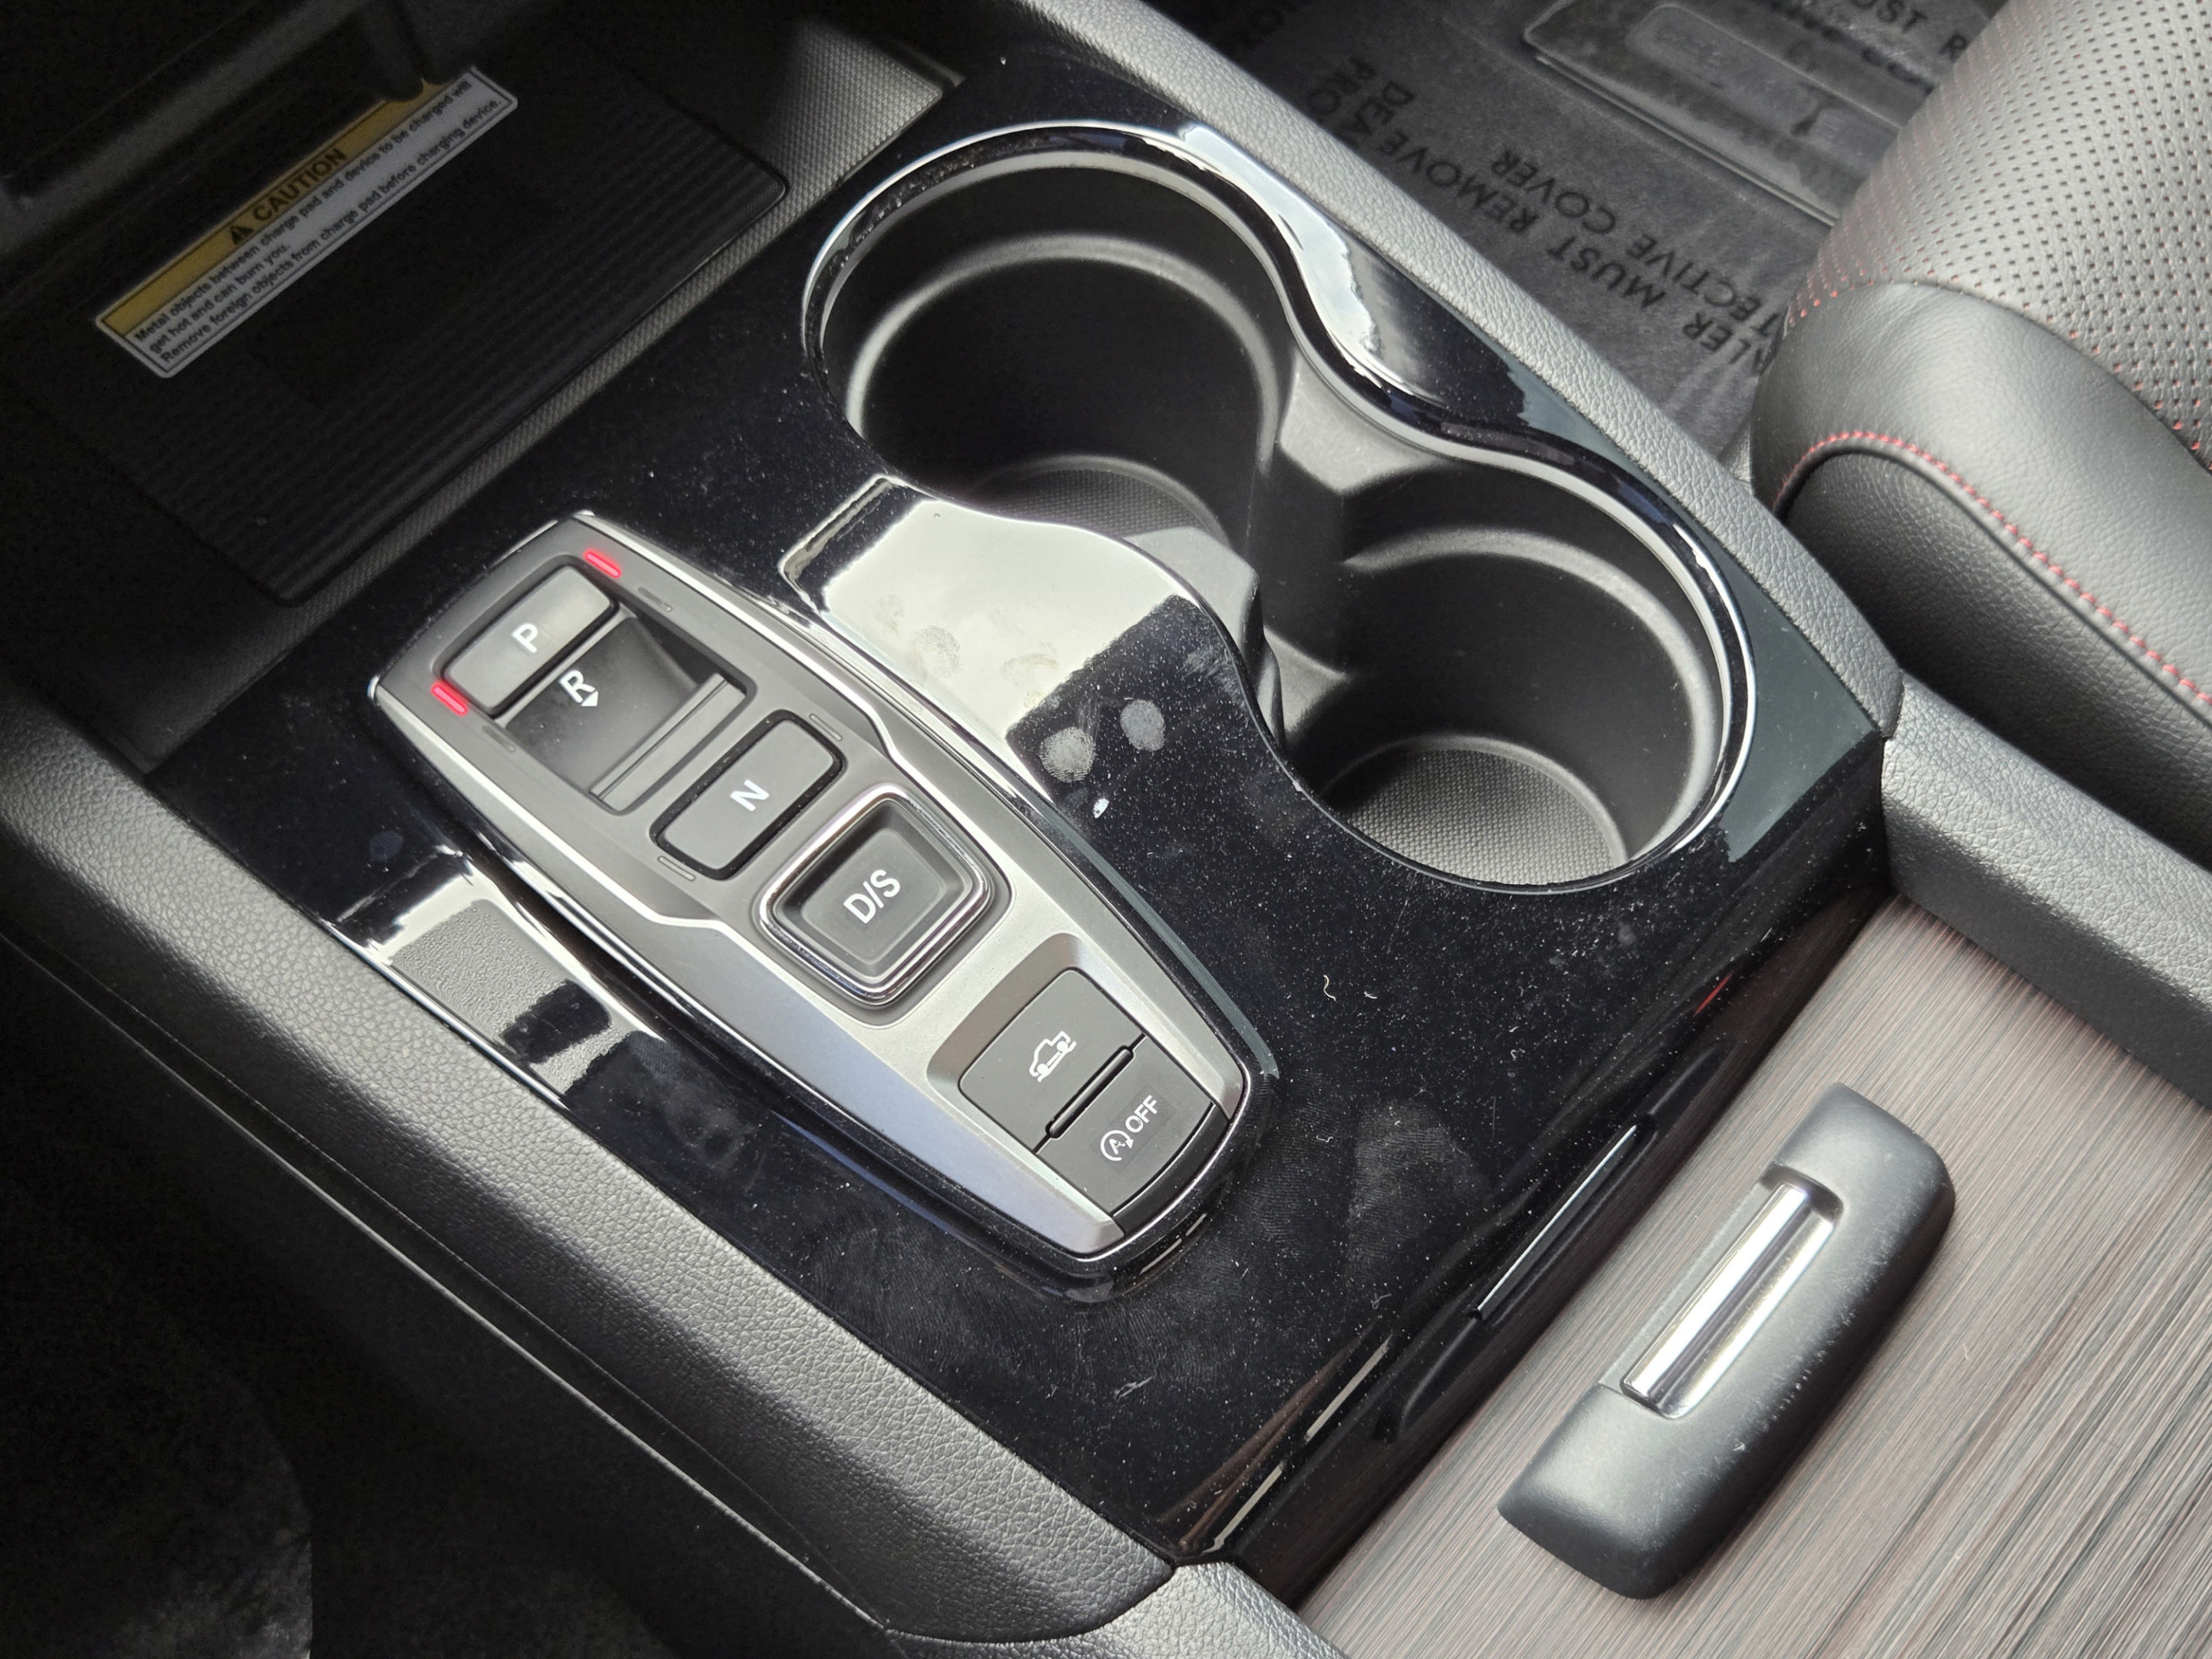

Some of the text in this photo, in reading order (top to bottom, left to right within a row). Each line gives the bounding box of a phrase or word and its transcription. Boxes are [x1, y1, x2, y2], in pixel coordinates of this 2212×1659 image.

[134, 81, 472, 342] Metal objects between charge pad and device to be charged will
[253, 148, 346, 220] CAUTION
[160, 100, 503, 363] Remove foreign objects from charge pad before charging device.
[1378, 131, 1771, 376] ALER MUST REMOVE
[1491, 150, 1780, 339] TECTIVE COVER
[150, 244, 291, 354] get hot and can burn you.
[512, 623, 538, 654] P
[558, 670, 596, 704] R
[730, 779, 770, 812] N
[843, 869, 901, 924] D/S
[1124, 1094, 1158, 1134] OFF
